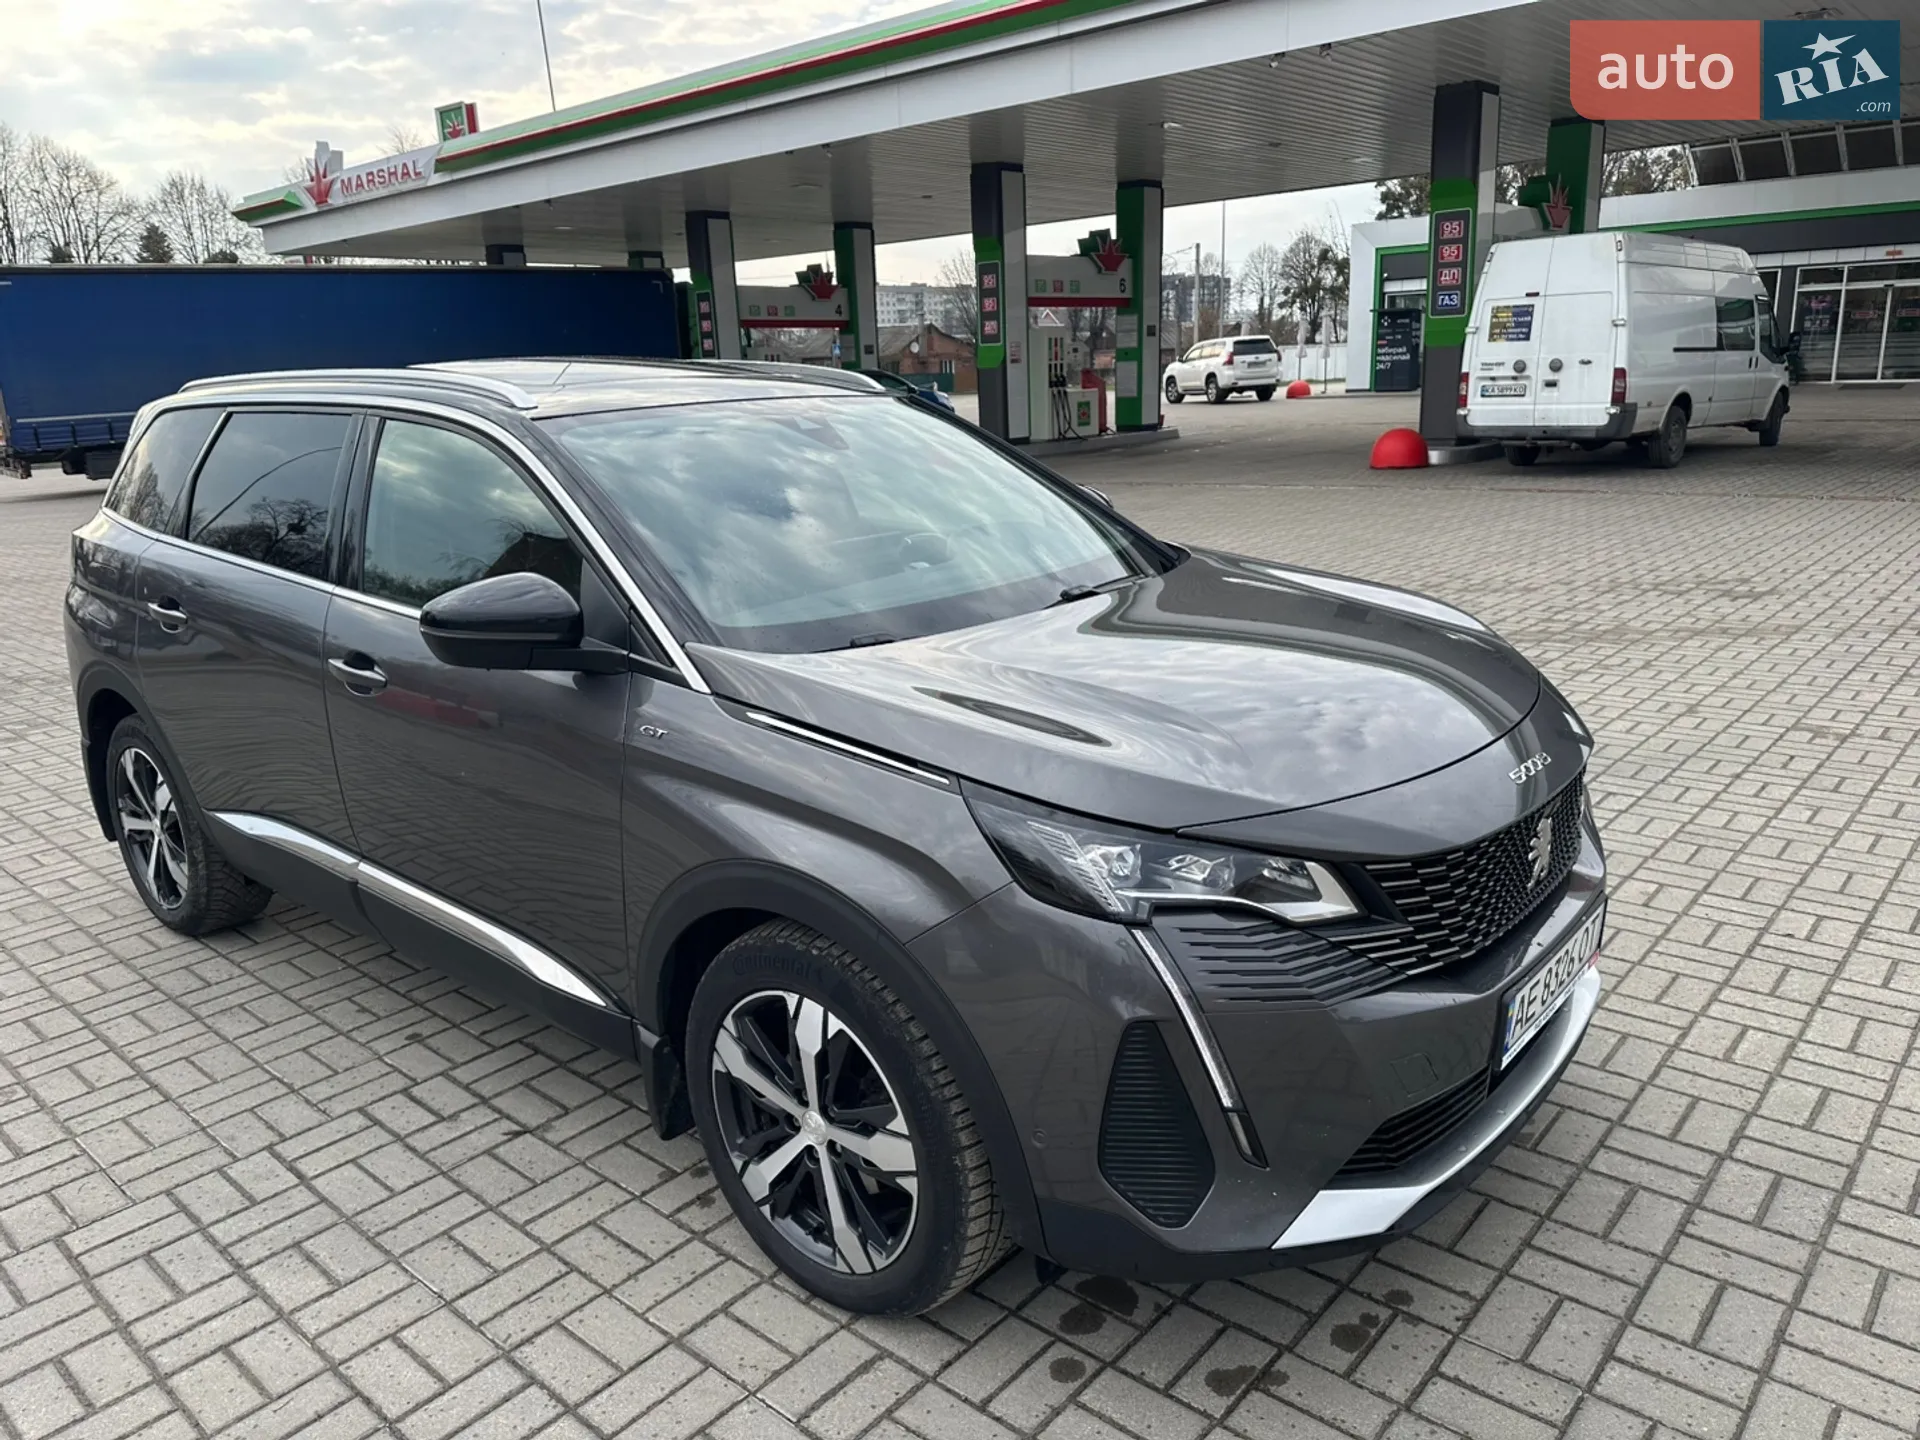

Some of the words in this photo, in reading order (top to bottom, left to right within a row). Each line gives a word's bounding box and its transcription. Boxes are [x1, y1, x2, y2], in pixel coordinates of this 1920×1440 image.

[340, 159, 423, 194] MARSHAL
[1443, 221, 1460, 233] 95
[1442, 246, 1458, 256] 95
[1440, 270, 1458, 280] ДП
[1119, 278, 1126, 293] 6
[1438, 295, 1457, 305] ГАЗ
[834, 304, 843, 316] 4
[640, 725, 669, 739] GT
[1508, 752, 1552, 784] 5008
